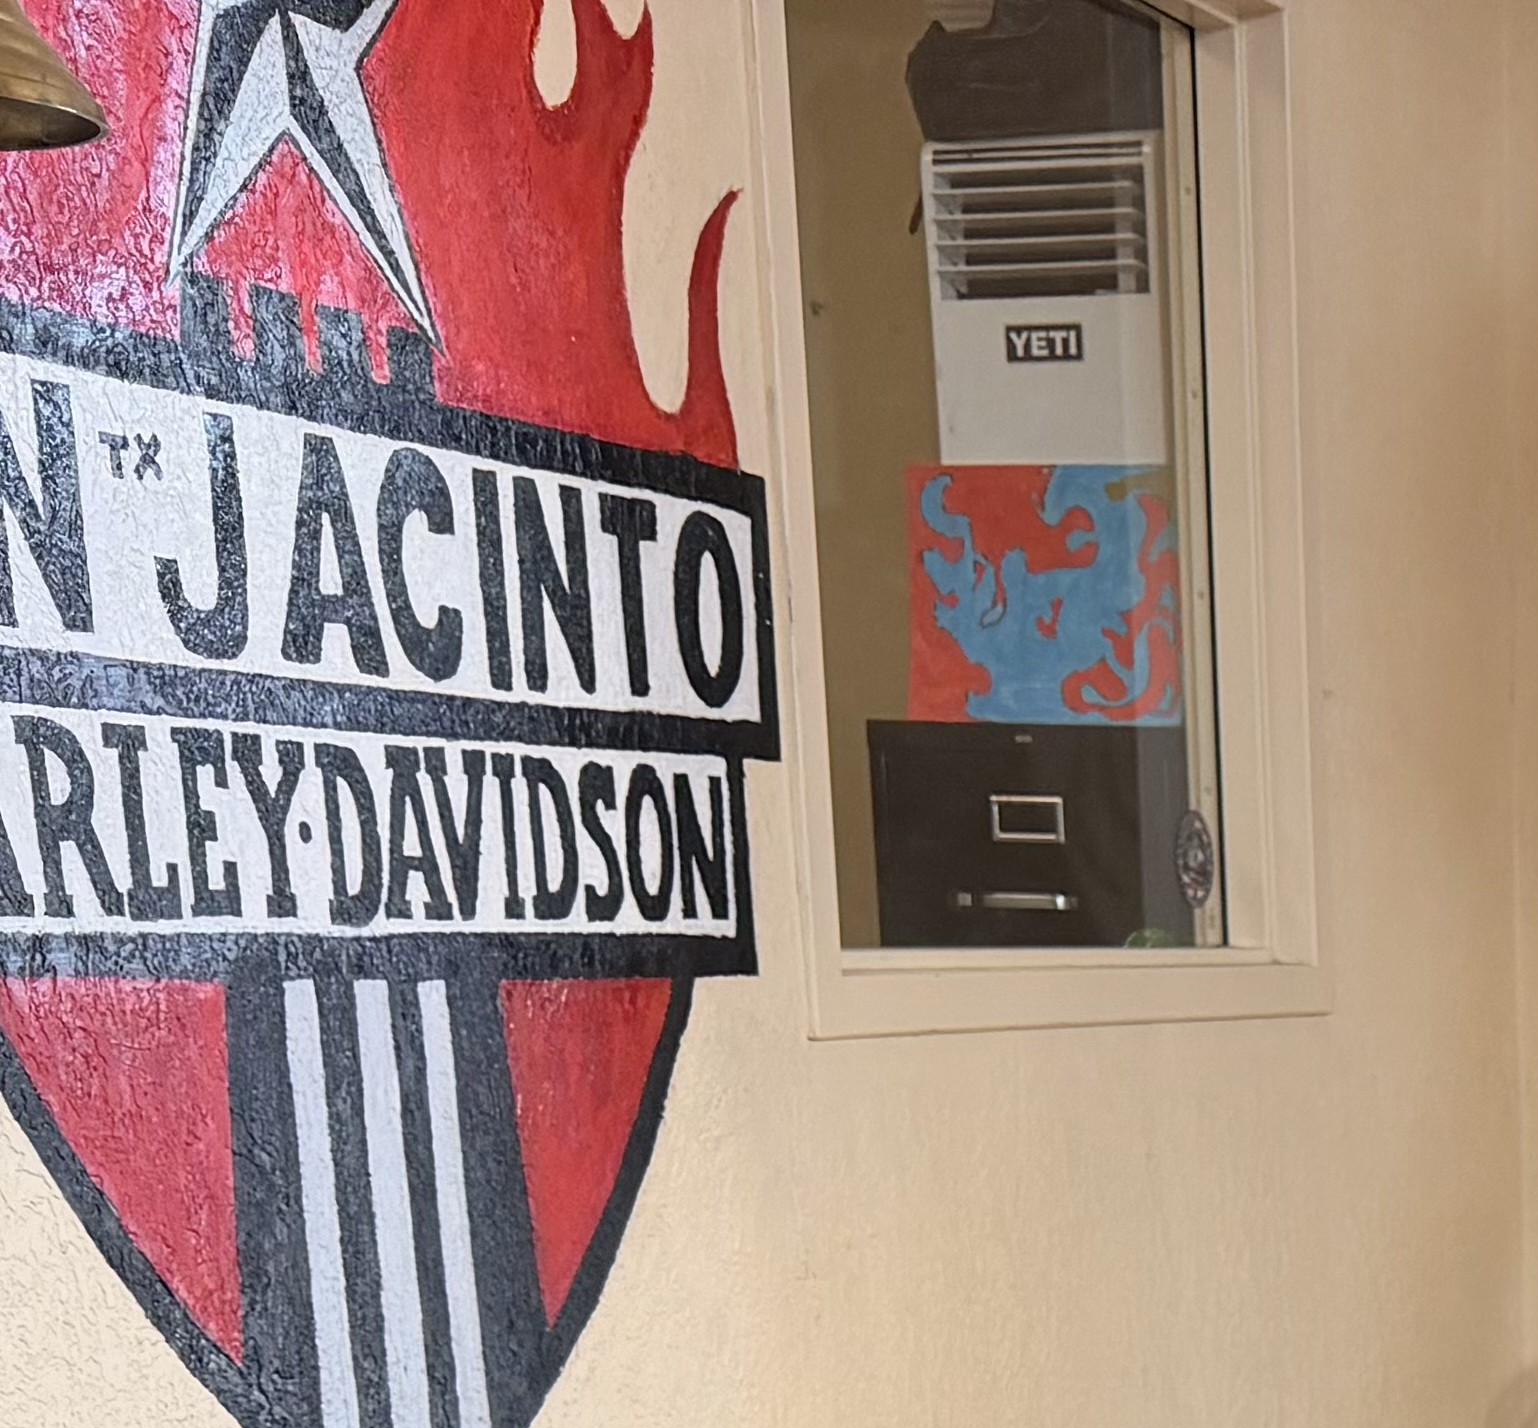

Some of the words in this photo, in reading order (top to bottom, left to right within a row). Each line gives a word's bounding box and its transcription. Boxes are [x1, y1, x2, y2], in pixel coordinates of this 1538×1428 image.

[1009, 329, 1078, 358] YETI
[98, 430, 163, 481] TX
[154, 411, 743, 709] JACINTO
